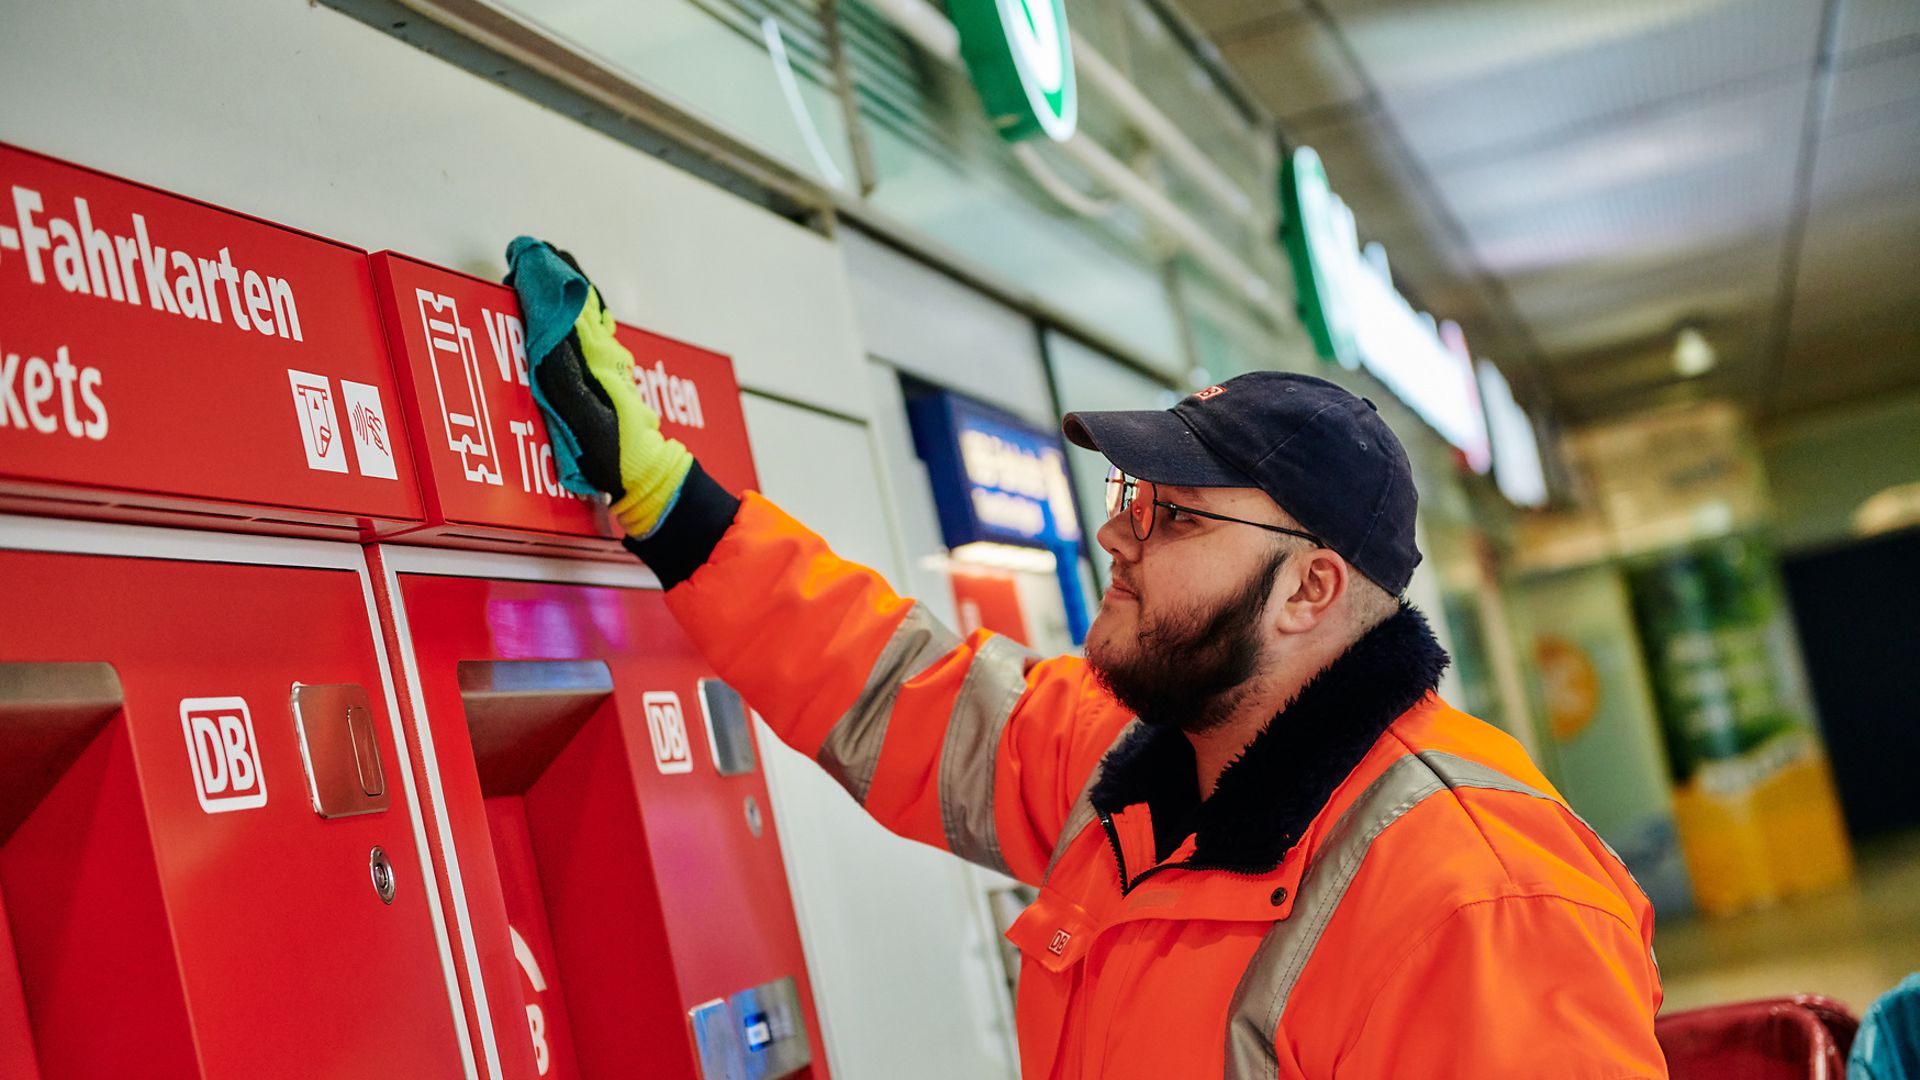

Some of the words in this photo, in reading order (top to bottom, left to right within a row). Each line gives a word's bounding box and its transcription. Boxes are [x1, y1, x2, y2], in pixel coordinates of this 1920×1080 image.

[0, 185, 303, 342] -Fahrkarten
[0, 345, 109, 440] kets
[481, 307, 530, 387] VB
[633, 359, 704, 429] arten
[509, 420, 574, 498] Tic
[188, 713, 258, 796] DB
[648, 703, 689, 762] DB
[1049, 931, 1069, 952] DB
